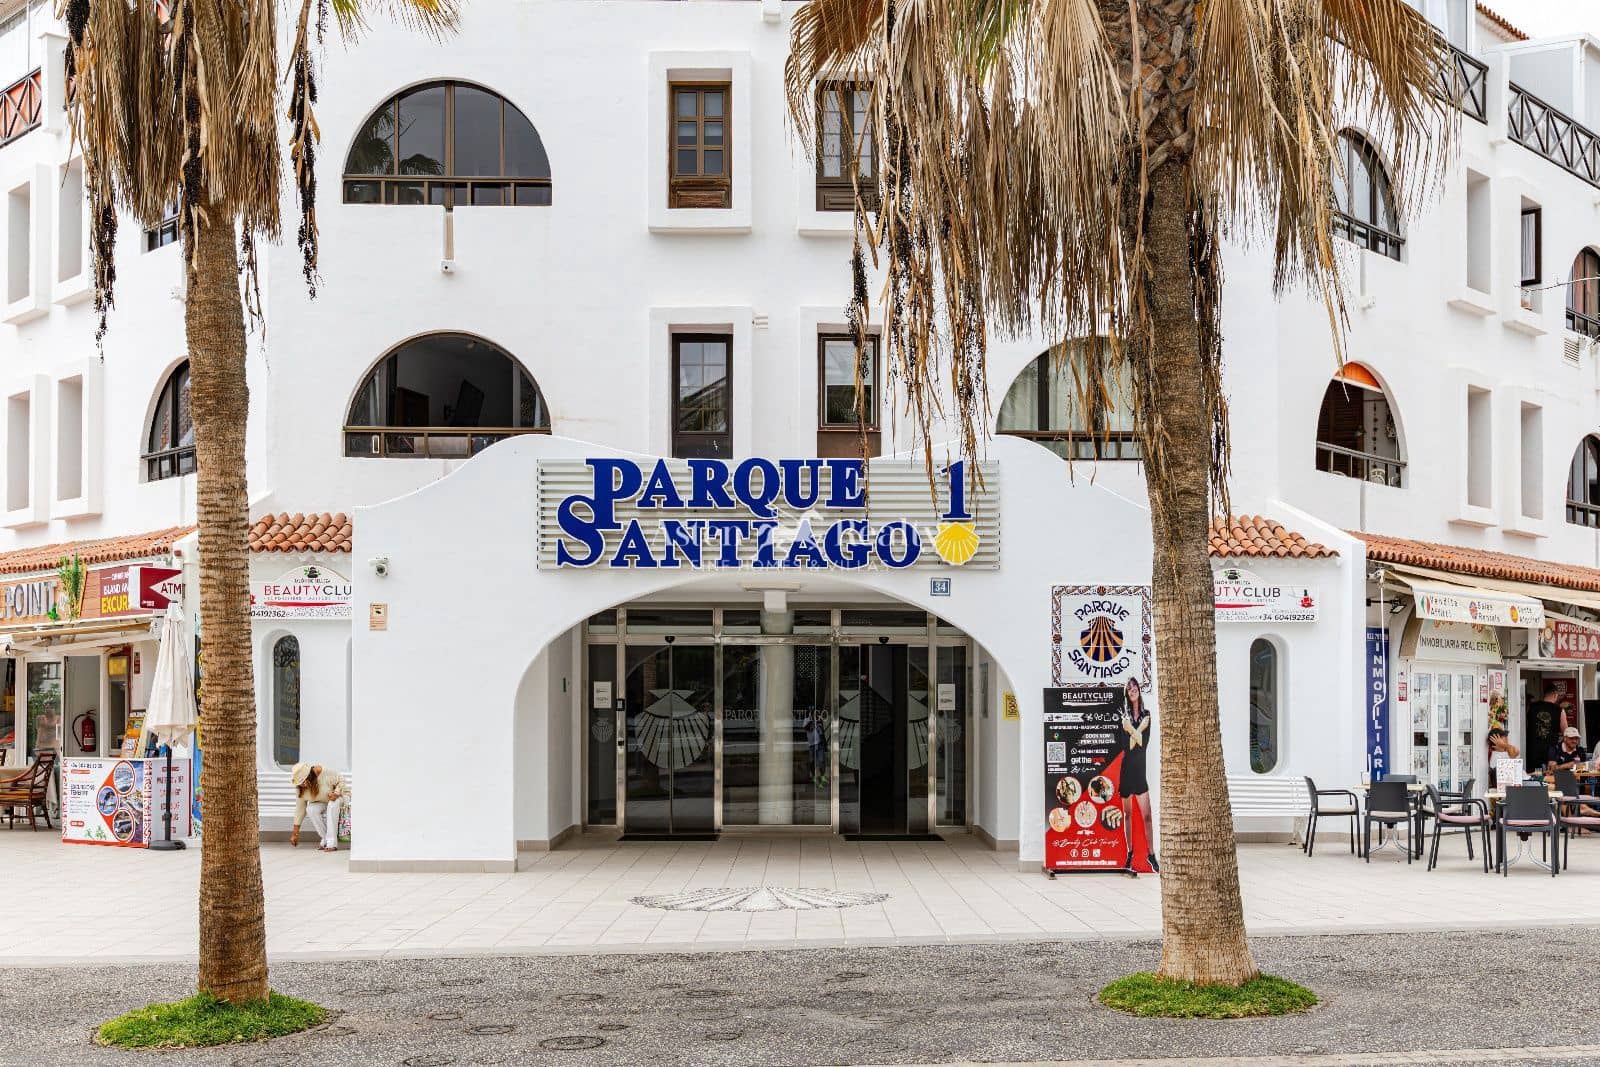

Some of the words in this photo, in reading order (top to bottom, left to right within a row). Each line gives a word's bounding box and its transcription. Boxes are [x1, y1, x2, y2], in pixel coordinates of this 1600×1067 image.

[585, 457, 867, 530] PARQUE
[939, 459, 972, 519] 1
[555, 494, 924, 568] SANTIAGO
[160, 582, 182, 595] ATM
[264, 585, 352, 596] BEAUTYCLU
[101, 594, 129, 614] EXCUR
[1074, 600, 1130, 621] PARQUE
[1420, 635, 1460, 649] INMOBILIARIA
[1460, 640, 1476, 651] REAL
[1476, 641, 1498, 653] ESTATE
[1557, 632, 1600, 652] KEBA
[1067, 649, 1130, 678] SANTIAGO
